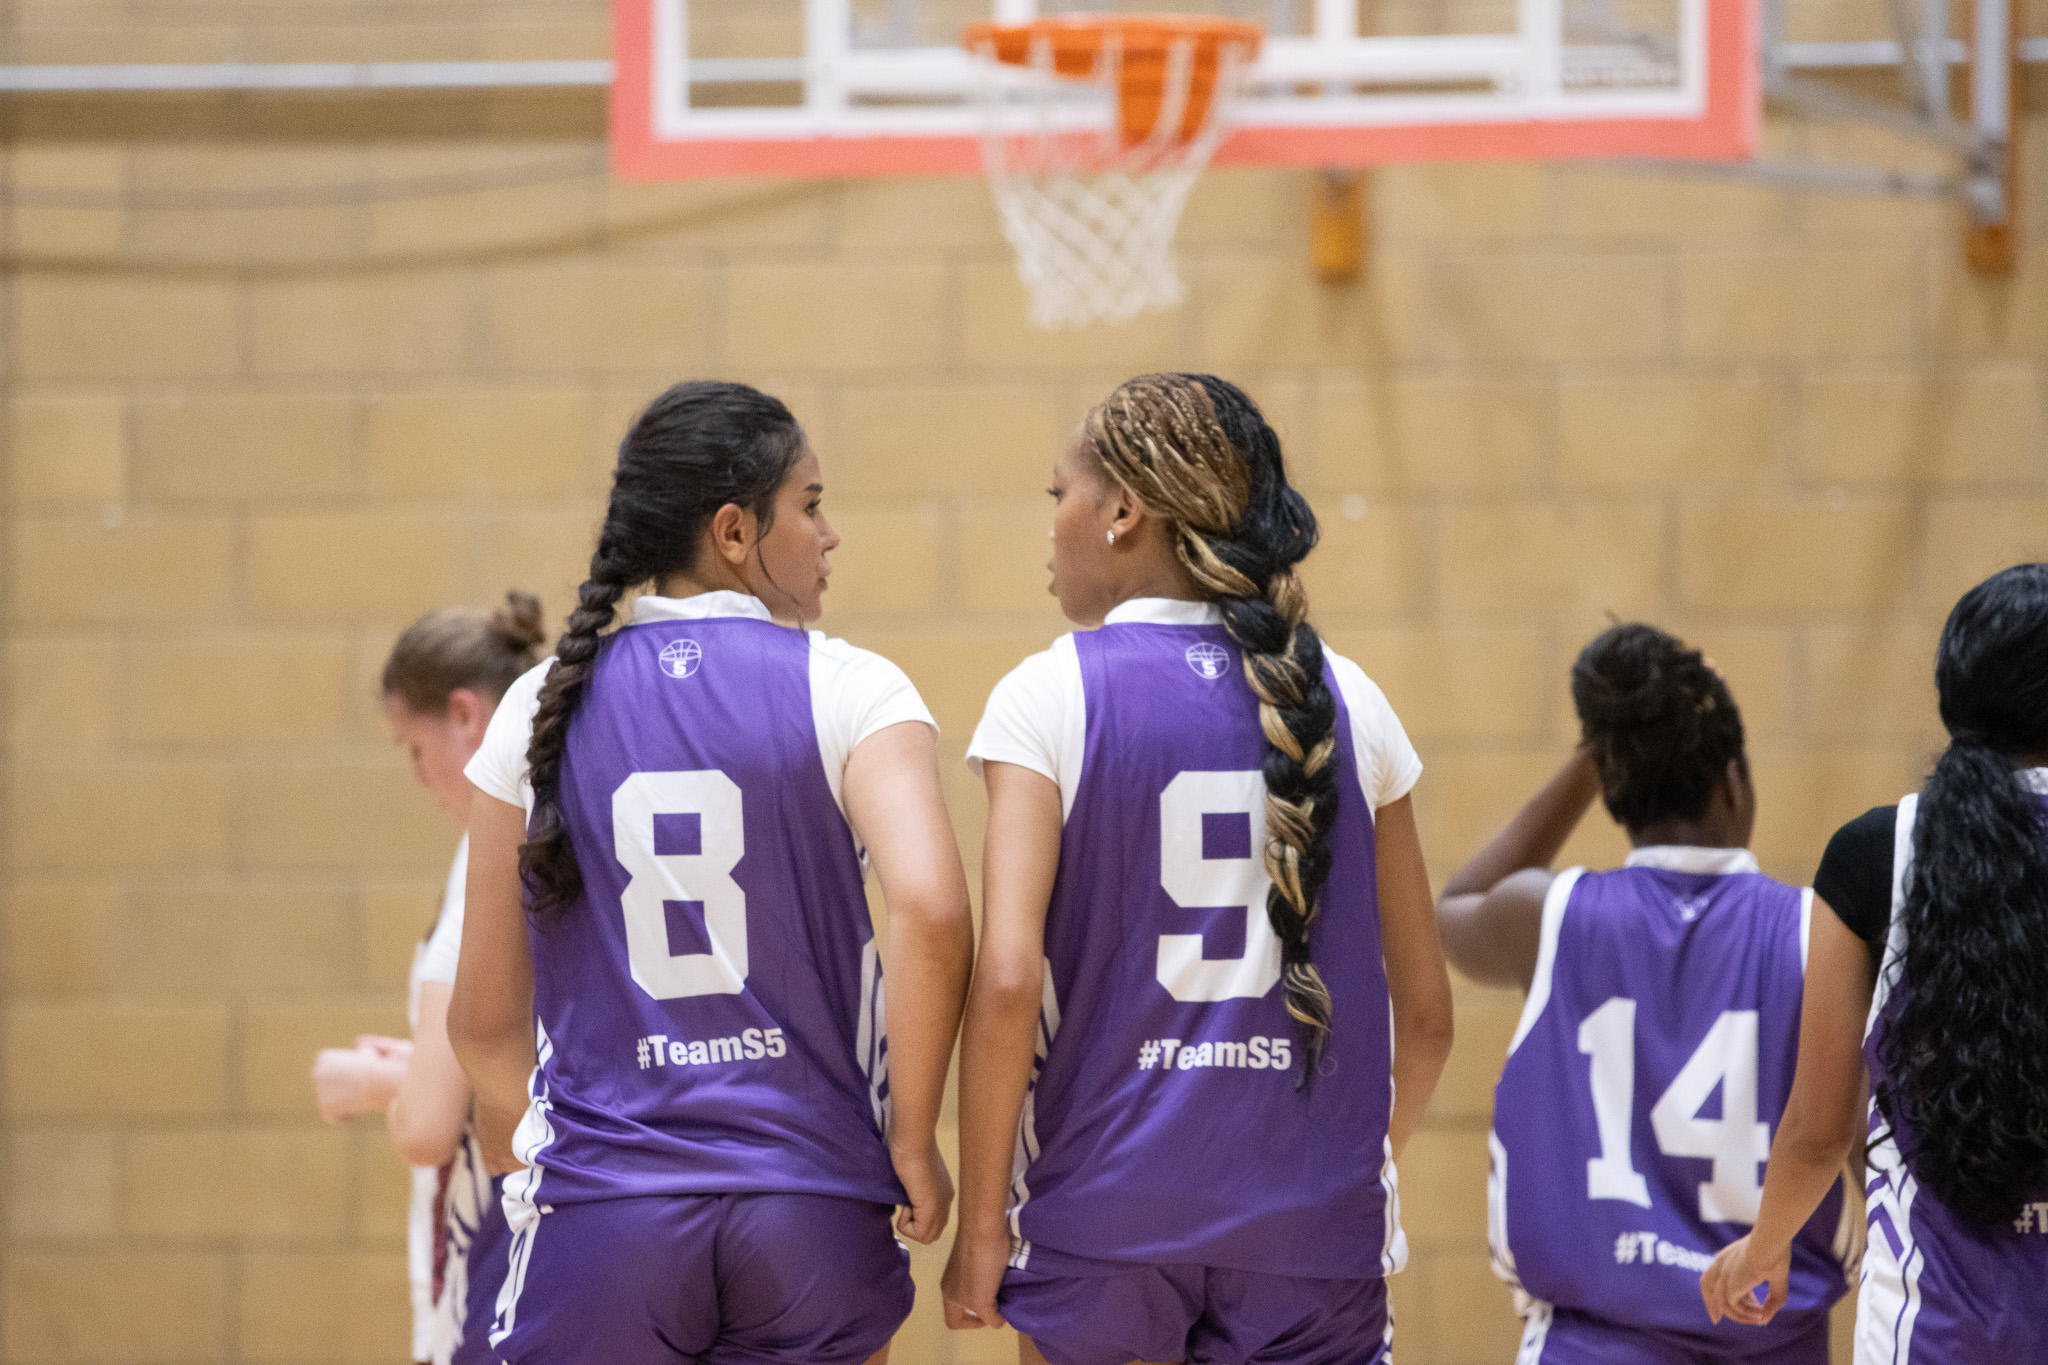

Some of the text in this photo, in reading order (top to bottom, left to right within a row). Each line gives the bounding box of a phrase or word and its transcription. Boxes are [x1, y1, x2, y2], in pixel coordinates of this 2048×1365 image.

[612, 769, 749, 1000] 8
[1156, 770, 1282, 1001] 9
[637, 1028, 787, 1069] #TeamS5
[1138, 1036, 1292, 1070] #TeamS5
[1578, 997, 1770, 1225] 14
